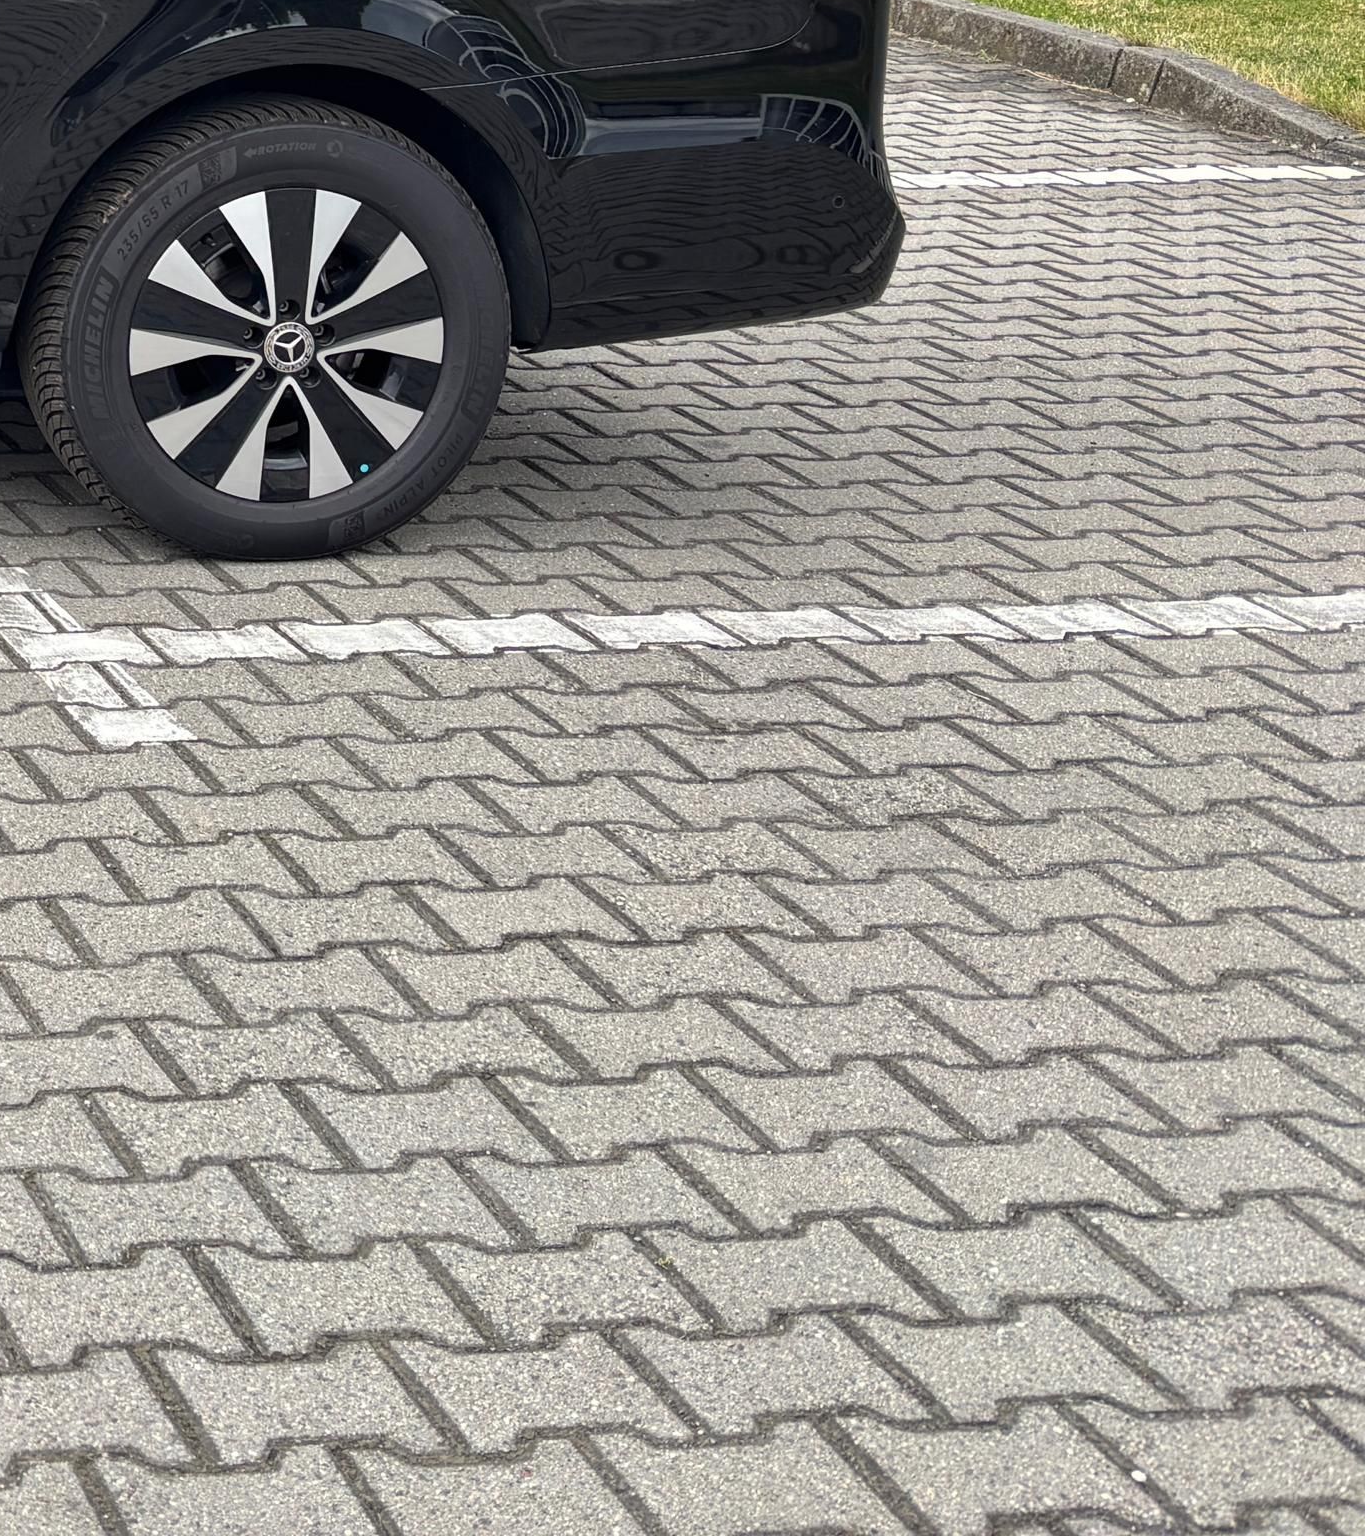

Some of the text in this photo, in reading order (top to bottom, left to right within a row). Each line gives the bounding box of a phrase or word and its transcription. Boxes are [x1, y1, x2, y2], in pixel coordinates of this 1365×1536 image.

[257, 141, 317, 156] ROTATION
[117, 180, 190, 262] 235/55 R 17
[84, 276, 116, 421] MICHELIN
